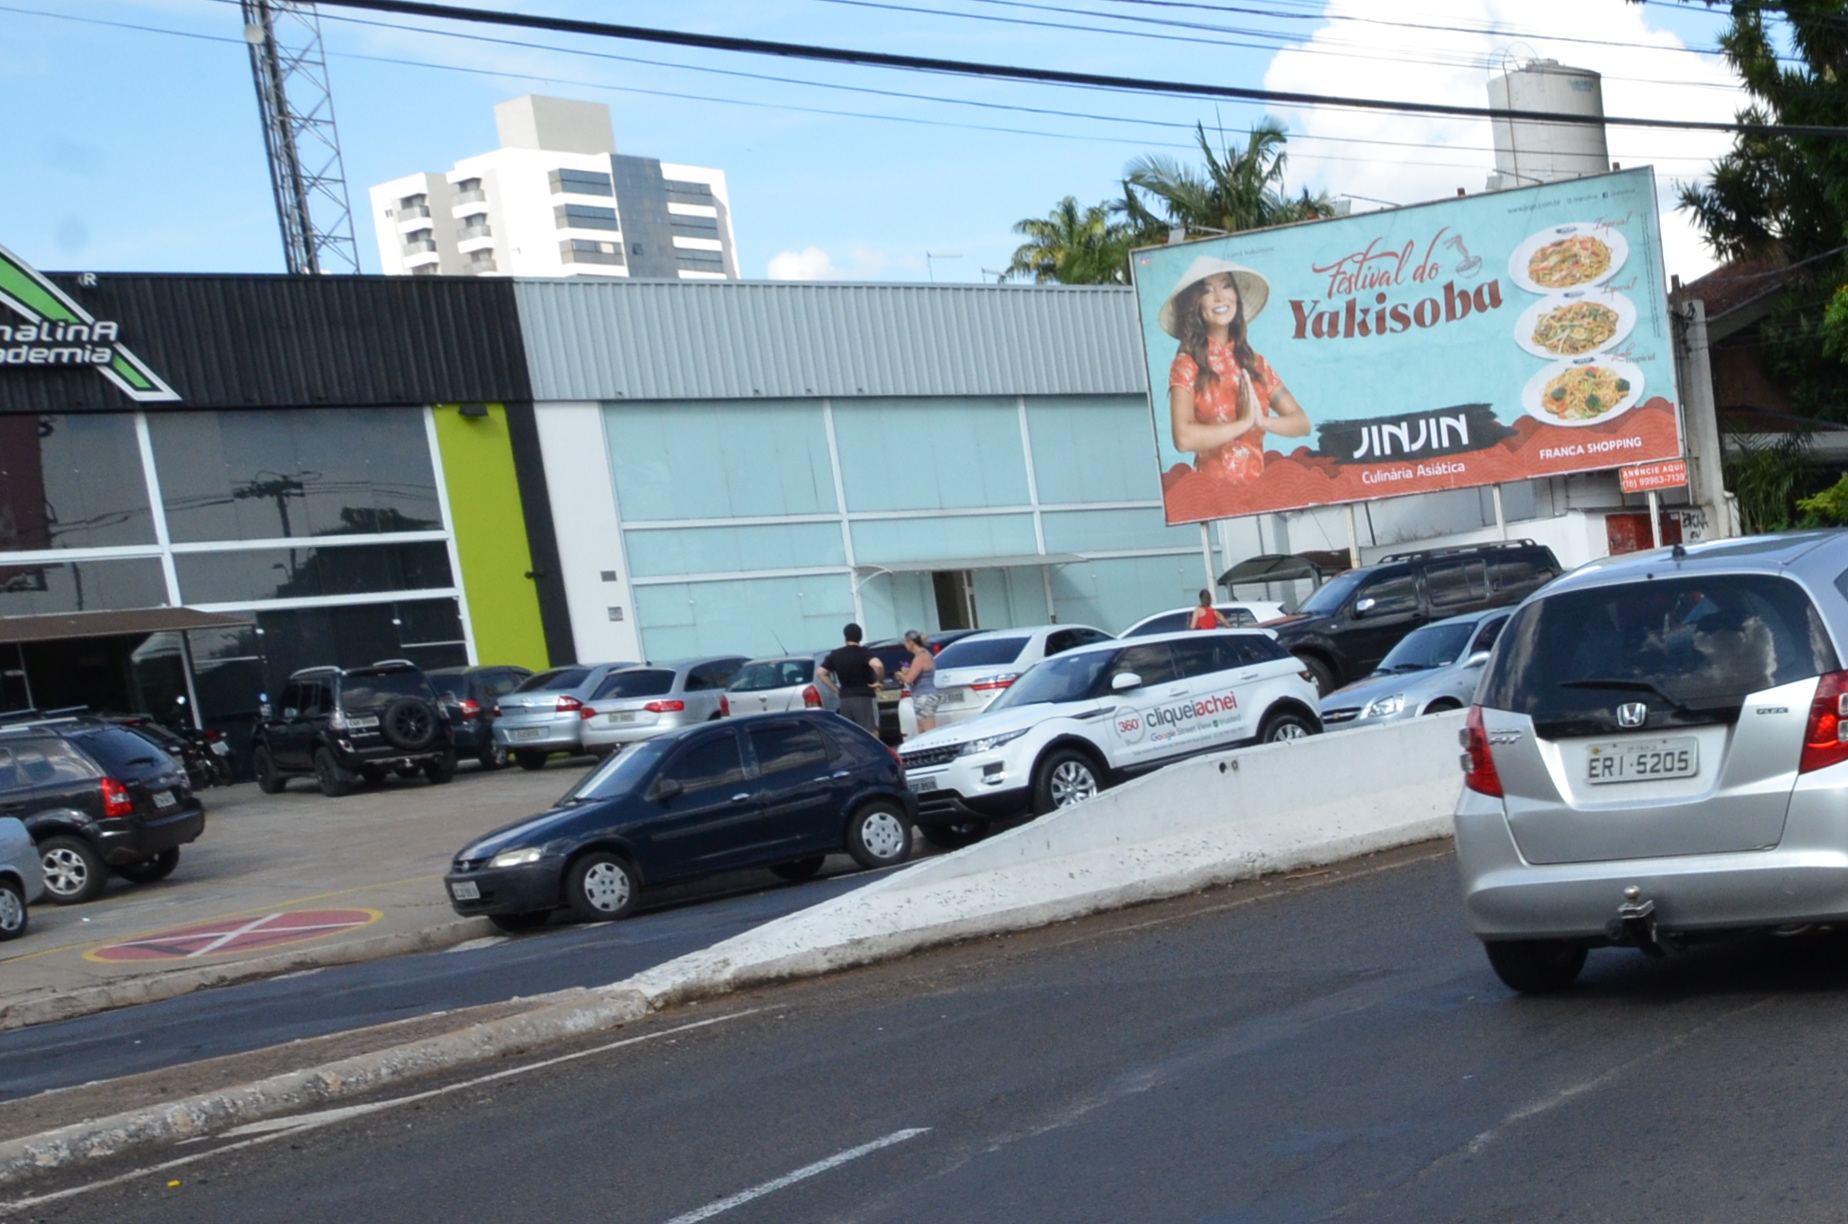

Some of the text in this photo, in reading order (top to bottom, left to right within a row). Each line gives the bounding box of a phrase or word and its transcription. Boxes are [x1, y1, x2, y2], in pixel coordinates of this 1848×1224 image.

[1312, 226, 1451, 300] Festival do
[1288, 278, 1504, 340] Yakisoba
[1352, 413, 1469, 460] JINJIN
[1539, 436, 1642, 461] FRANCA SHOPPING
[1361, 460, 1466, 485] Culinária Asiática
[1662, 463, 1684, 473] AQUI
[1622, 477, 1638, 490] (16)
[1145, 690, 1238, 728] cliqueiachei
[1151, 730, 1176, 742] Google
